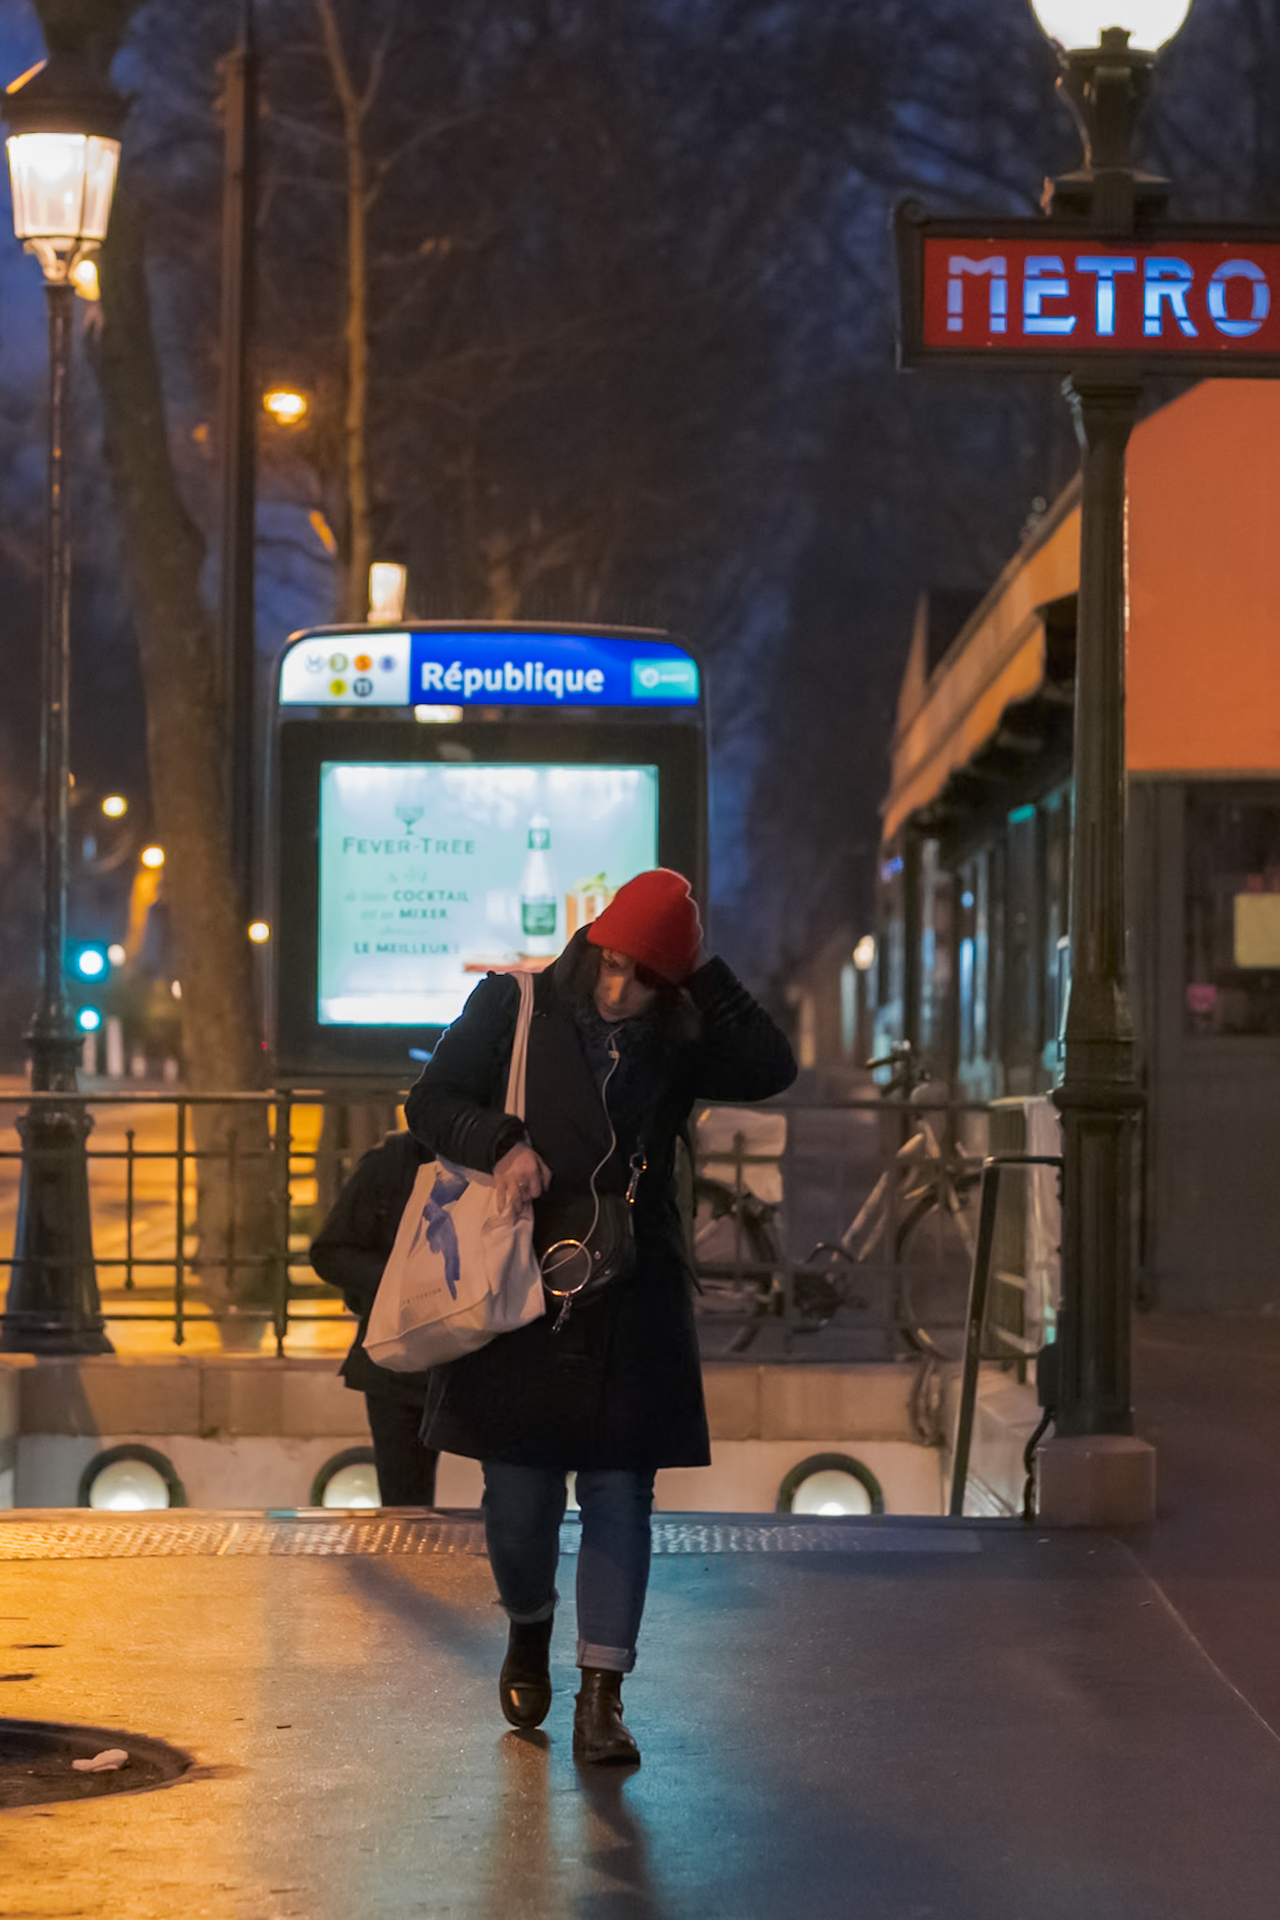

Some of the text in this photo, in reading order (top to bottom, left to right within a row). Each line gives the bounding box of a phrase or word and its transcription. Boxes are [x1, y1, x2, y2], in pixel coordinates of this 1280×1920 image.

[947, 255, 1271, 338] METRO
[421, 660, 604, 698] République
[392, 889, 469, 902] COCKTAIL
[399, 908, 447, 918] MIXER
[354, 942, 369, 953] LE
